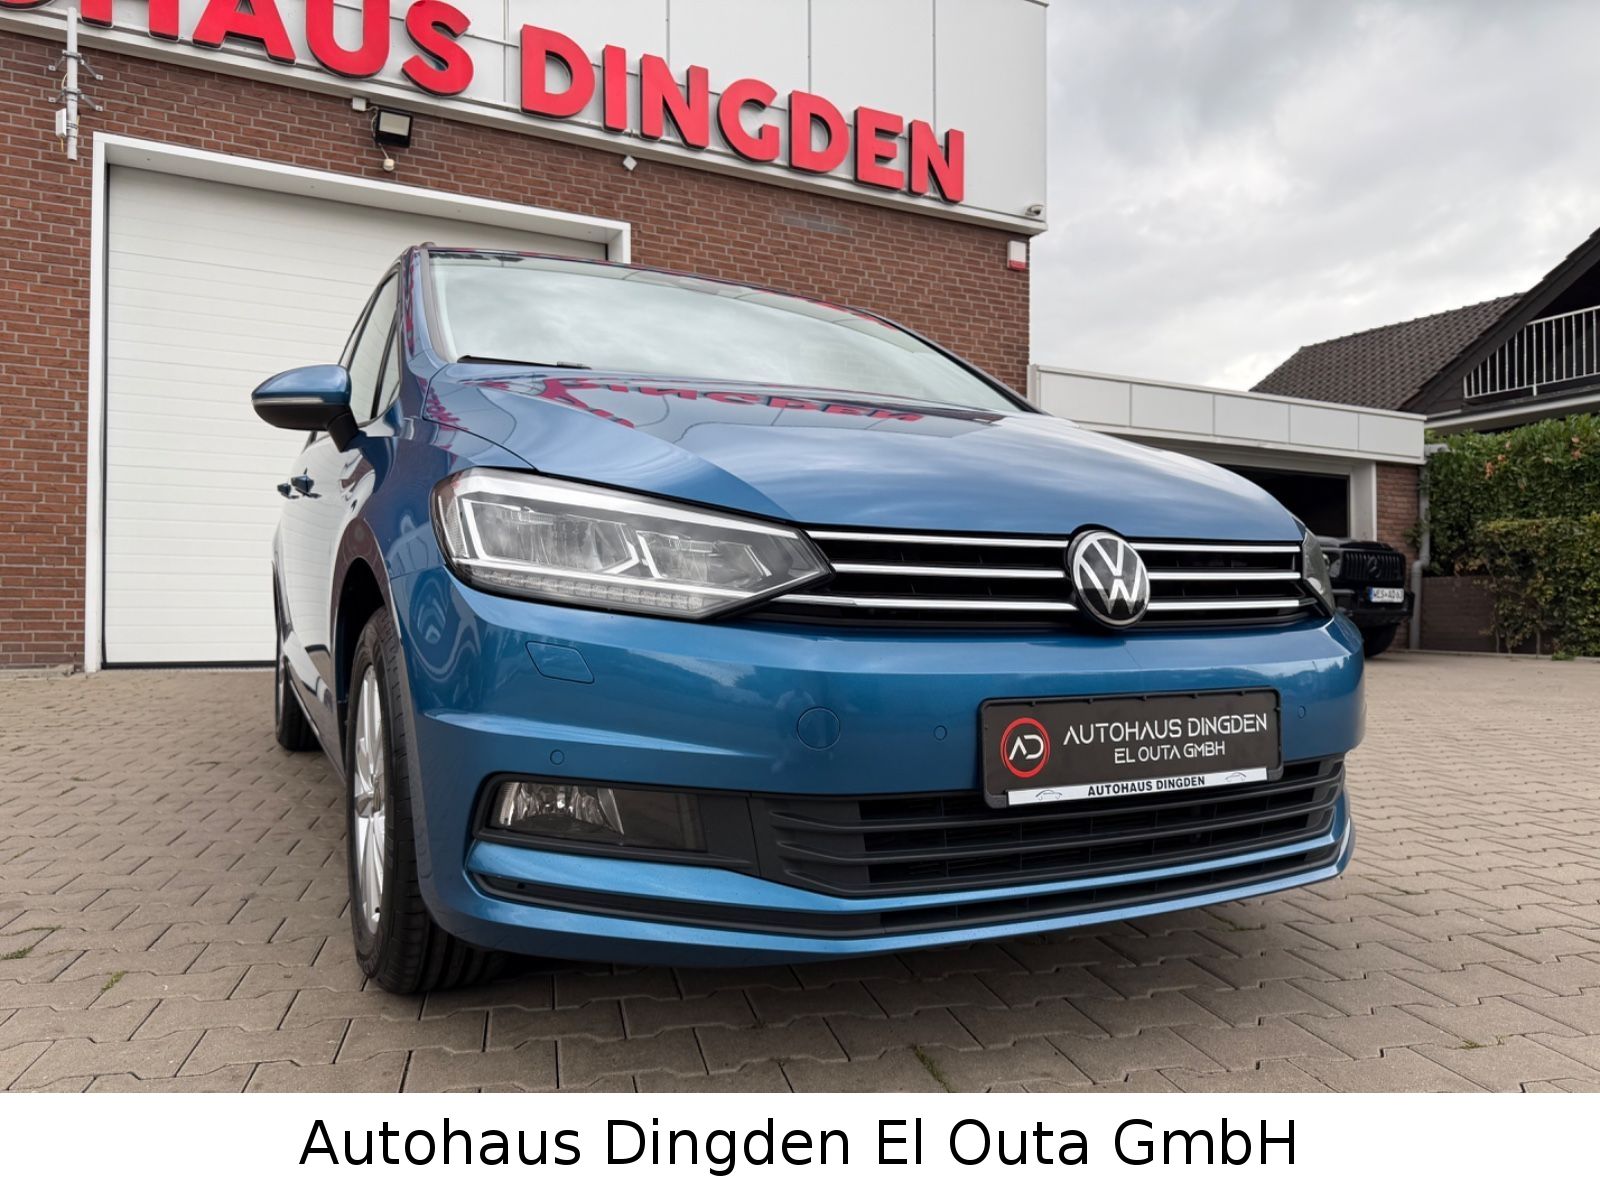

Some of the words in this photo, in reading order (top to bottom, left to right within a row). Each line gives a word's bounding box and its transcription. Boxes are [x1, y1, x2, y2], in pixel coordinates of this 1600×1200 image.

[0, 0, 475, 95] AUS
[520, 24, 964, 202] DINGDEN
[1074, 532, 1148, 622] VW
[1063, 718, 1183, 746] AUTOHAUS
[1187, 712, 1268, 738] DINGDEN
[1114, 747, 1136, 764] EL
[1137, 744, 1182, 762] OUTA
[1183, 740, 1226, 758] GMBH
[1087, 779, 1154, 797] AUTOHAUS
[1155, 775, 1206, 791] DINGDEN
